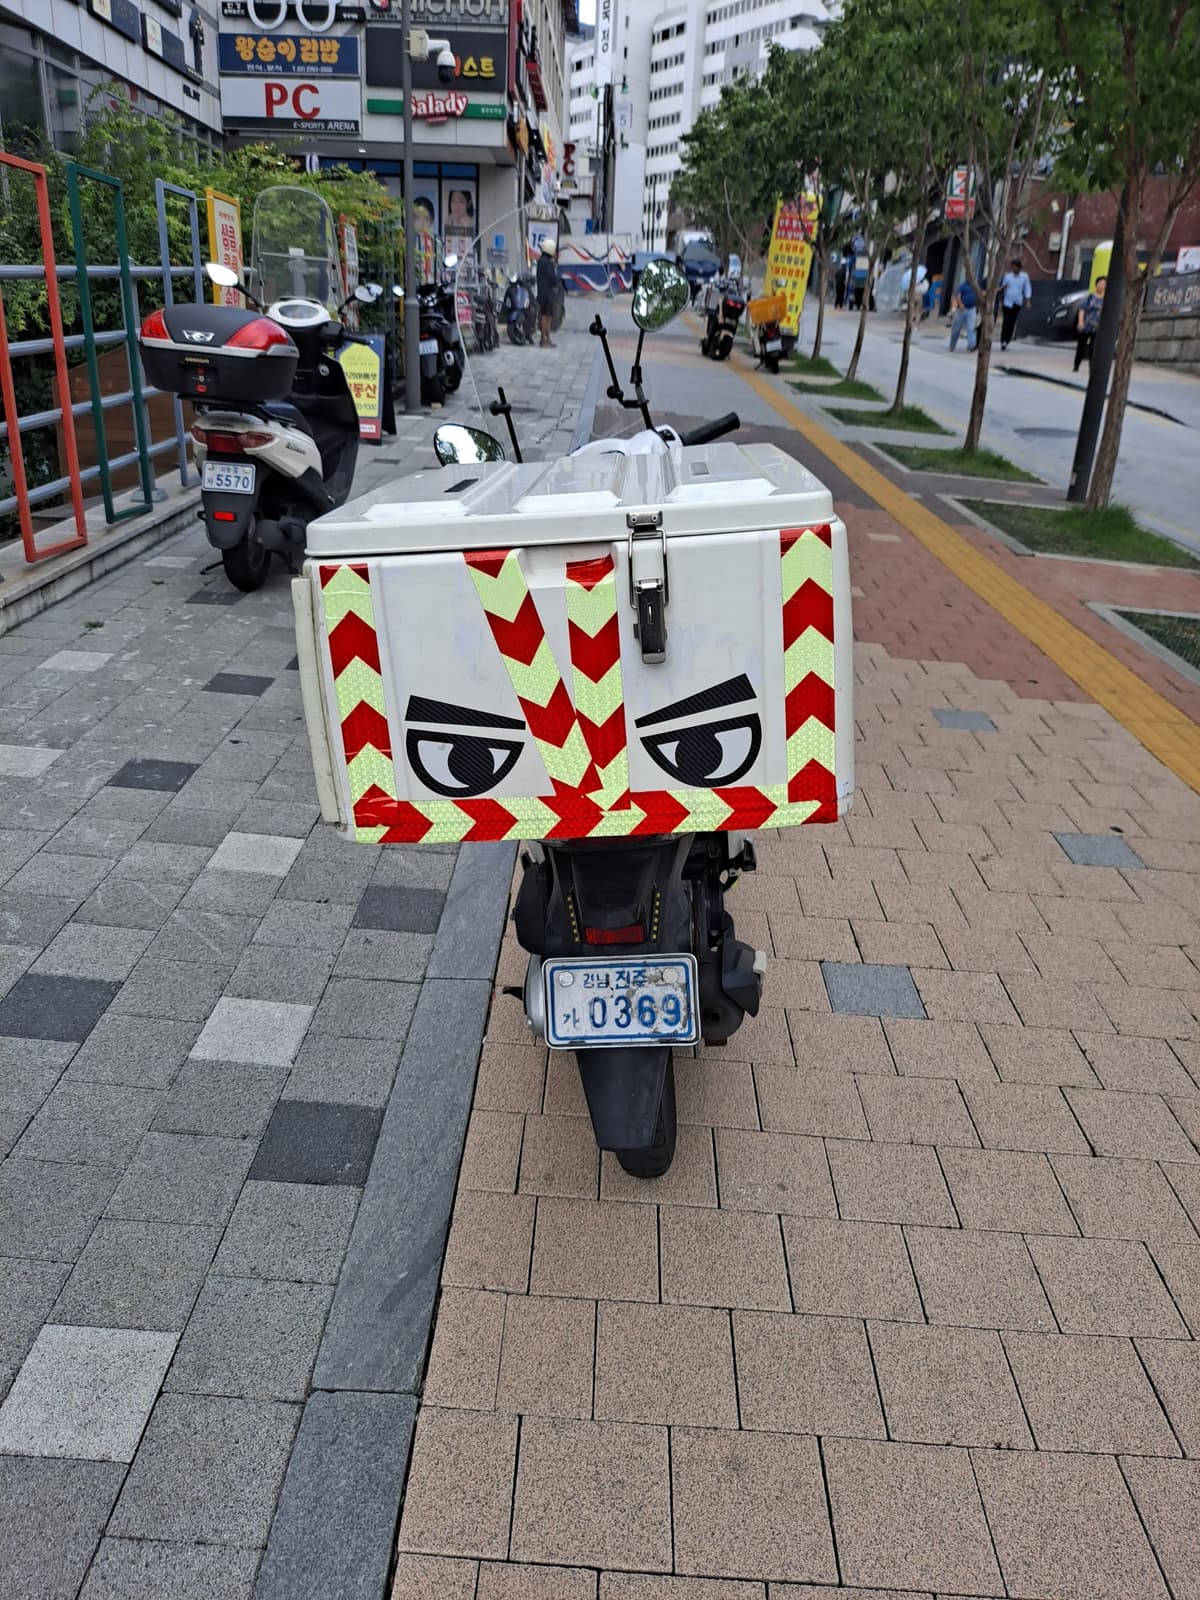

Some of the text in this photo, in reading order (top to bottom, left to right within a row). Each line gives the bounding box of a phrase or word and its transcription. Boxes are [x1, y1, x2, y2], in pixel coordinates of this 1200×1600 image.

[235, 36, 341, 64] 왕순이 김밥
[264, 82, 321, 121] PC
[326, 121, 356, 132] ARENA
[563, 143, 576, 177] PC
[216, 473, 250, 489] 5570
[615, 969, 648, 990] 진주
[562, 993, 681, 1029] 가 0369
